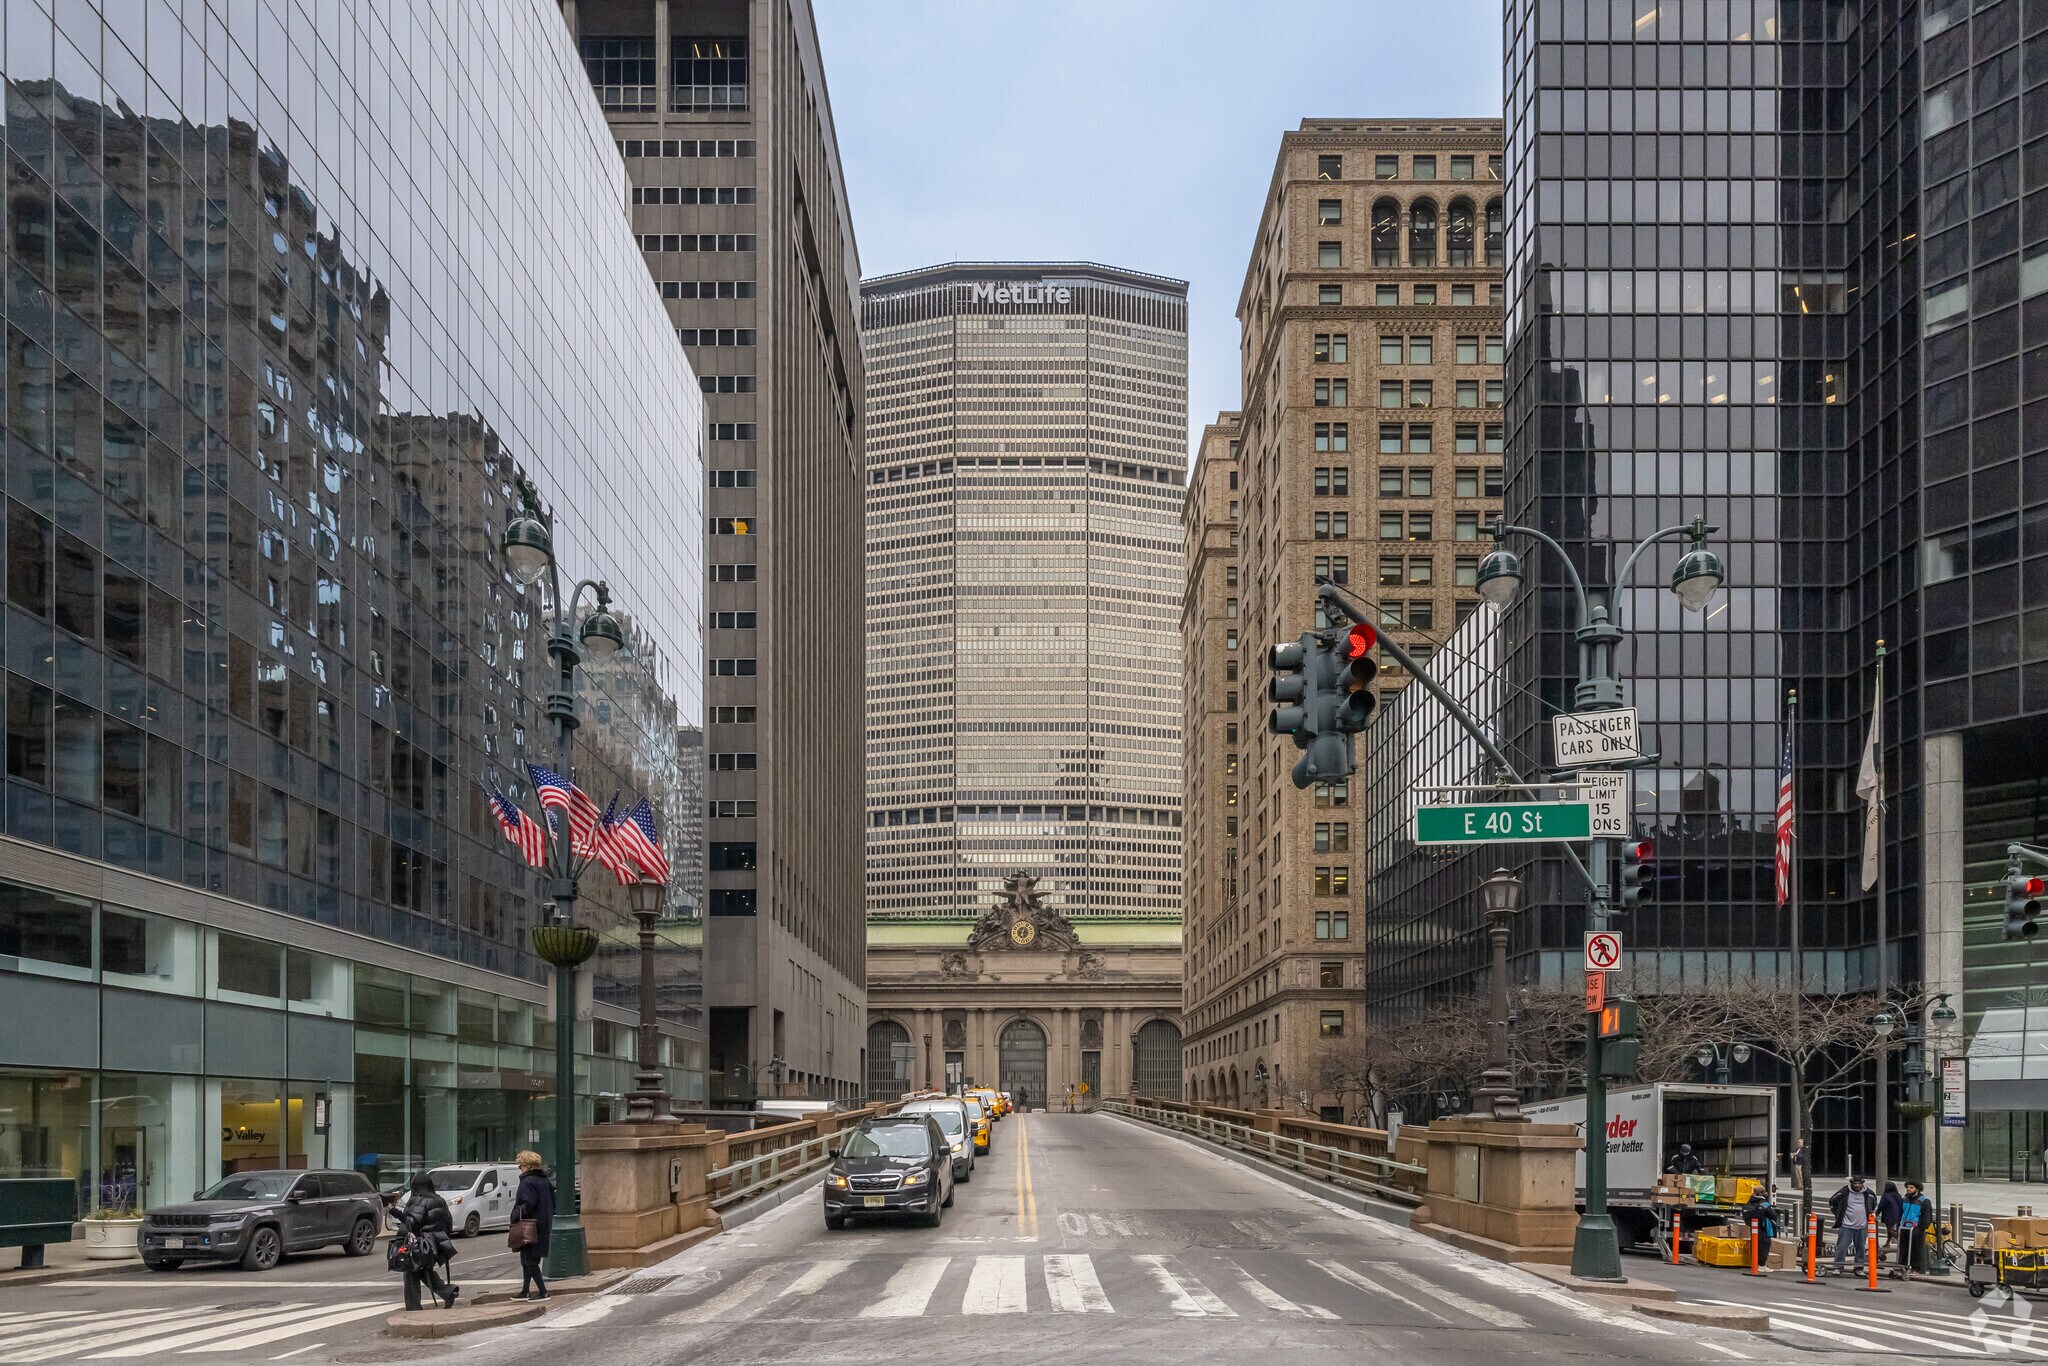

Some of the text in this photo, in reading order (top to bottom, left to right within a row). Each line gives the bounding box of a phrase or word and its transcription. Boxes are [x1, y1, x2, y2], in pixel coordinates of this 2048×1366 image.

[972, 282, 1070, 304] MetLife
[1560, 716, 1631, 736] PASSENGER
[1561, 735, 1632, 756] CARS ONLY
[1582, 777, 1624, 787] WEIGHT
[1589, 790, 1617, 800] LIMIT
[1595, 803, 1610, 815] 15
[1464, 811, 1543, 835] E 40 St
[1593, 818, 1621, 831] ONS
[1631, 1093, 1651, 1101] Ryder.com
[1605, 1114, 1638, 1138] der
[235, 1129, 266, 1143] Valley
[1605, 1140, 1644, 1153] Ever better.
